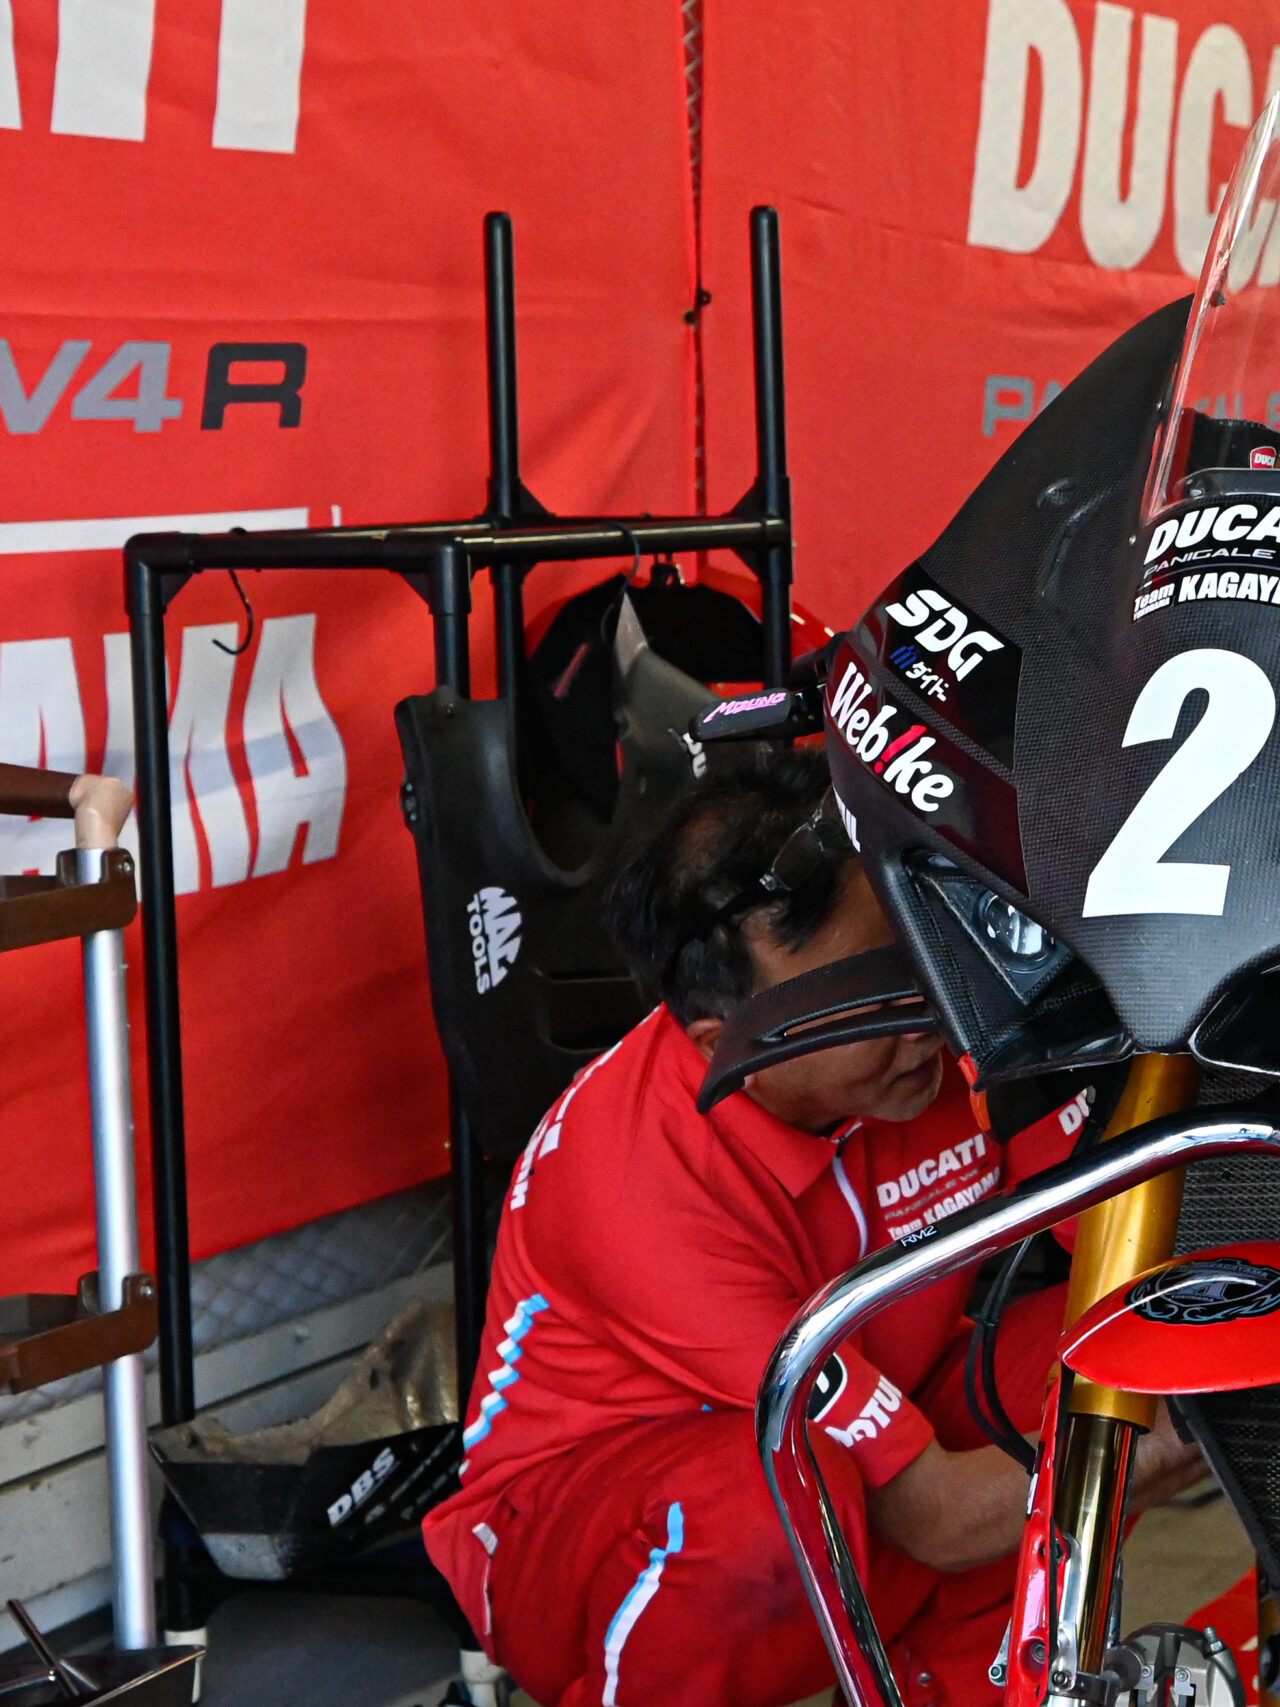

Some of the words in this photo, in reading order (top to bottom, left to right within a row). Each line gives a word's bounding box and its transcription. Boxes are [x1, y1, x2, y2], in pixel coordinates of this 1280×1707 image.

[1143, 547, 1277, 580] PANIGALE
[885, 589, 1004, 682] SDG
[1083, 649, 1277, 918] 2
[466, 891, 491, 995] TOOLS
[876, 1133, 986, 1208] DUCATI
[900, 1225, 938, 1248] RM2
